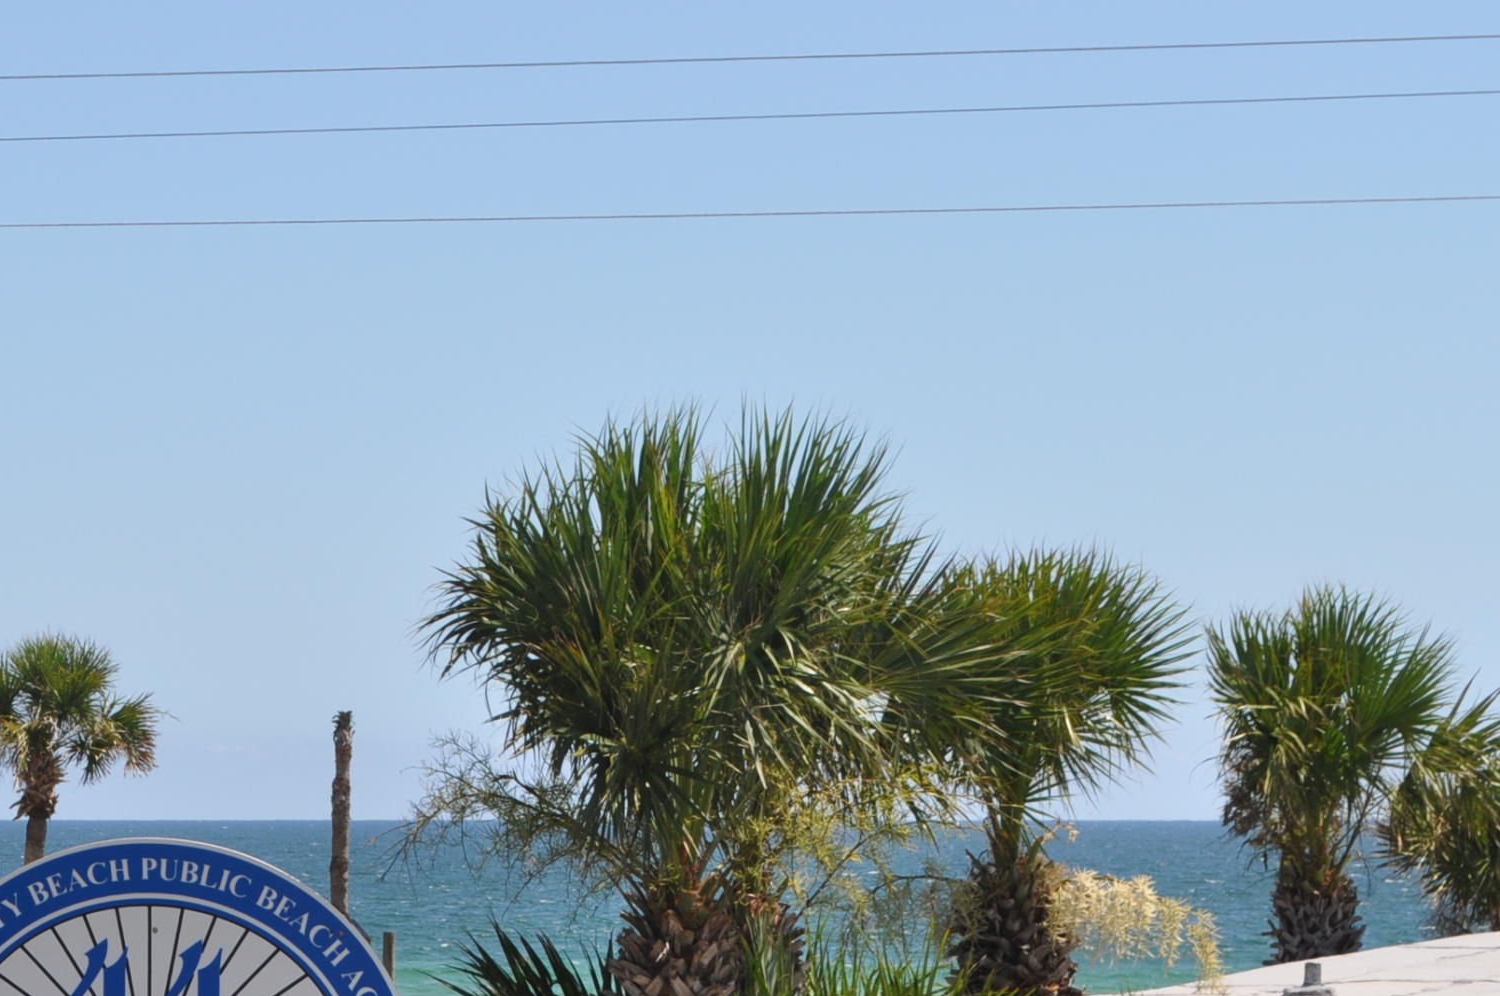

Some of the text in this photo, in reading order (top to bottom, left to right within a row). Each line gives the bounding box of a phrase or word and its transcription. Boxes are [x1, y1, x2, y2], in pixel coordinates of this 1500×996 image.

[27, 858, 131, 906] BEACH
[141, 857, 252, 898] PUBLIC
[256, 885, 350, 967] BEACH
